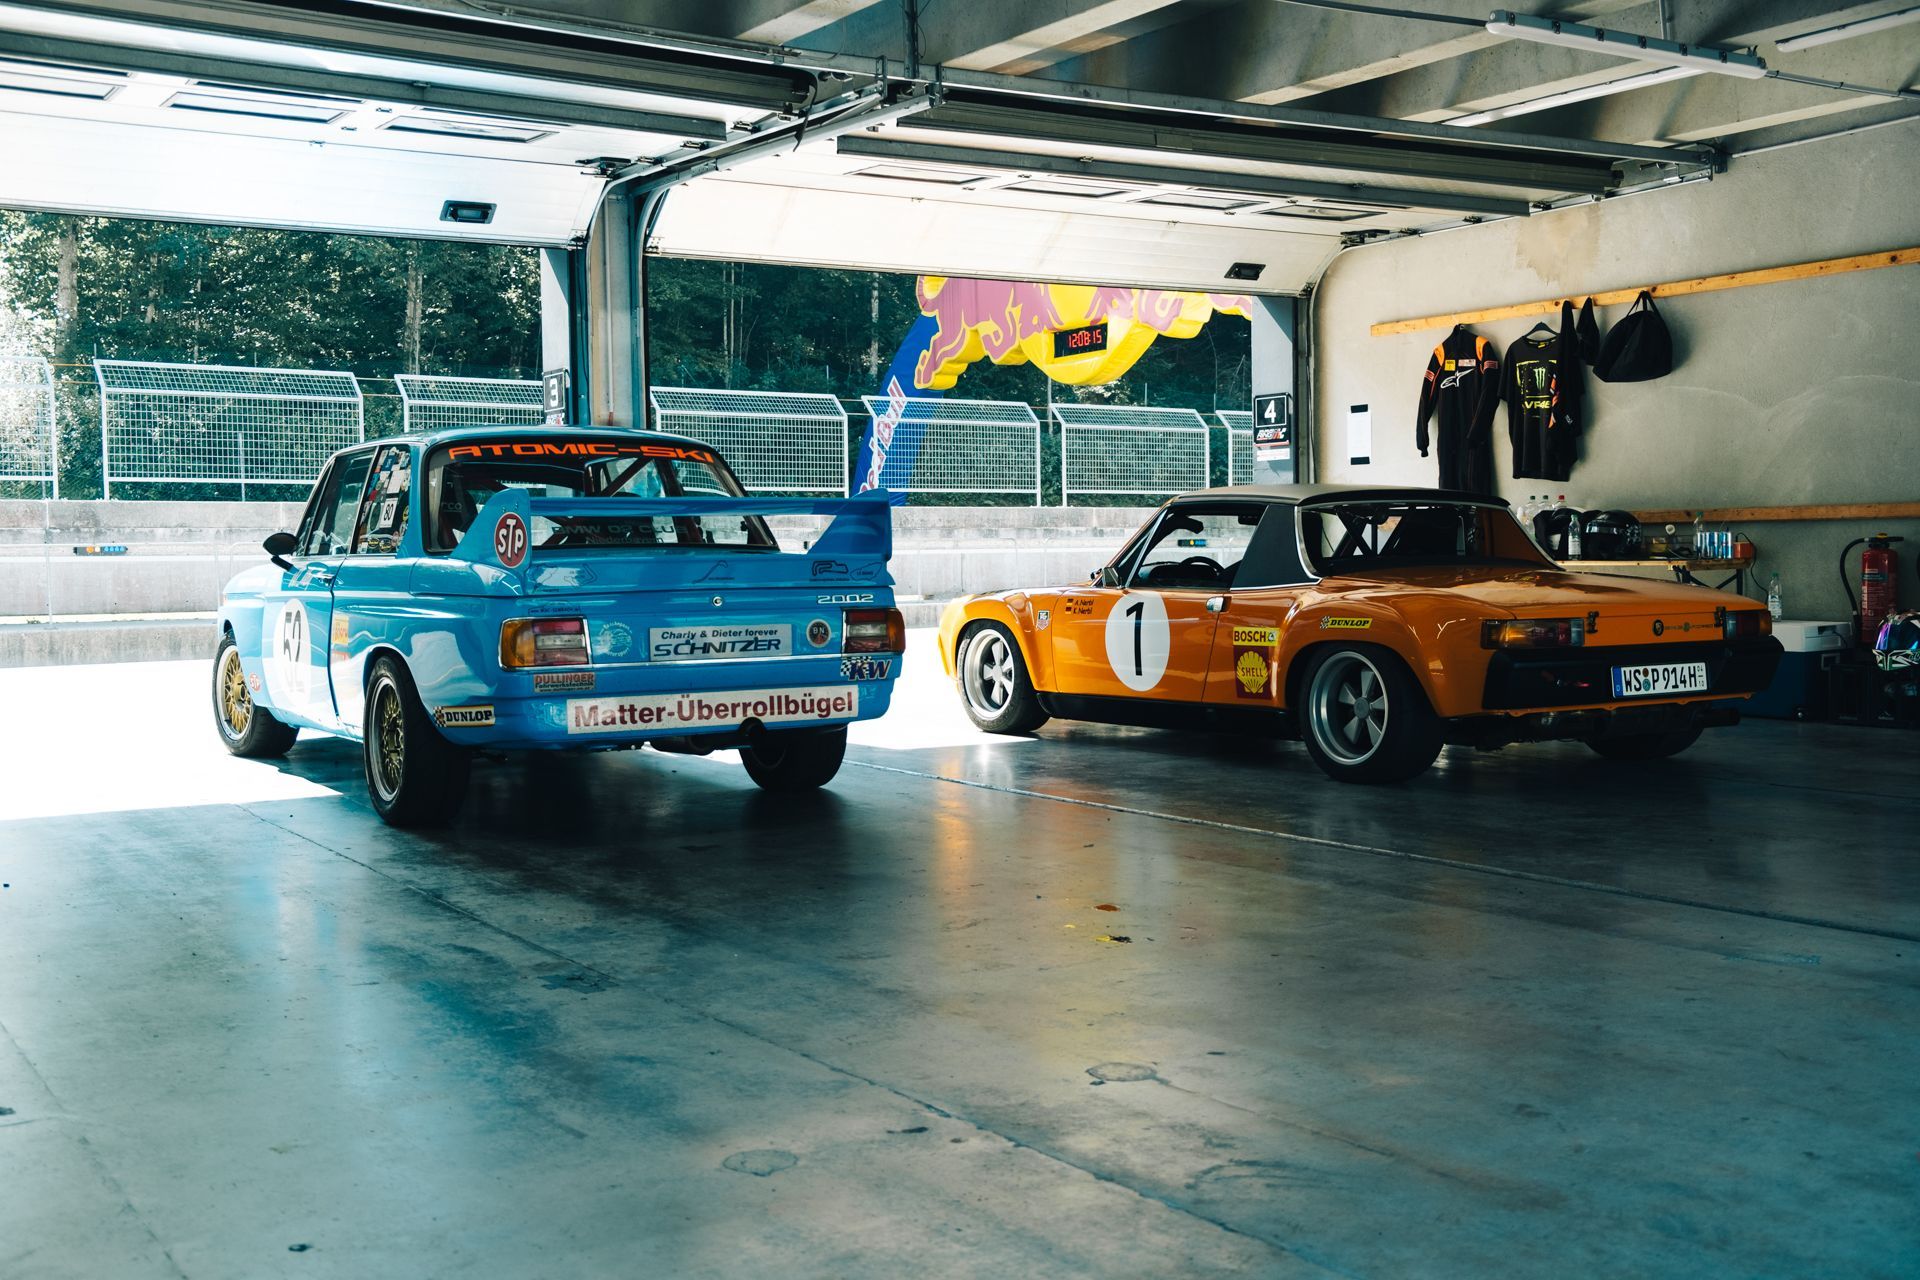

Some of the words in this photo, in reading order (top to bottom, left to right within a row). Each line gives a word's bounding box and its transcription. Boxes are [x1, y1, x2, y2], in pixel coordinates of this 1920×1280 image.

[549, 378, 559, 407] 3
[1264, 400, 1277, 423] 4
[448, 443, 714, 463] ATOMIC-SKI
[384, 504, 393, 520] 80
[498, 518, 524, 558] STP
[817, 594, 875, 604] 2002
[1330, 619, 1369, 627] DUNLOP
[284, 610, 302, 662] 52
[661, 631, 696, 641] Charly
[700, 630, 707, 638] &
[712, 629, 742, 637] Dieter
[745, 628, 778, 637] forever
[1127, 601, 1144, 676] 1
[1233, 630, 1267, 642] BOSCH
[653, 638, 781, 656] SCHNITZER
[535, 673, 594, 684] DULLINGER
[848, 660, 892, 680] KW
[1241, 666, 1263, 677] SHELL
[1623, 669, 1641, 692] WS
[1651, 668, 1659, 690] P
[445, 710, 493, 722] DUNLOP
[575, 692, 853, 727] Matter-Überrollbügel
